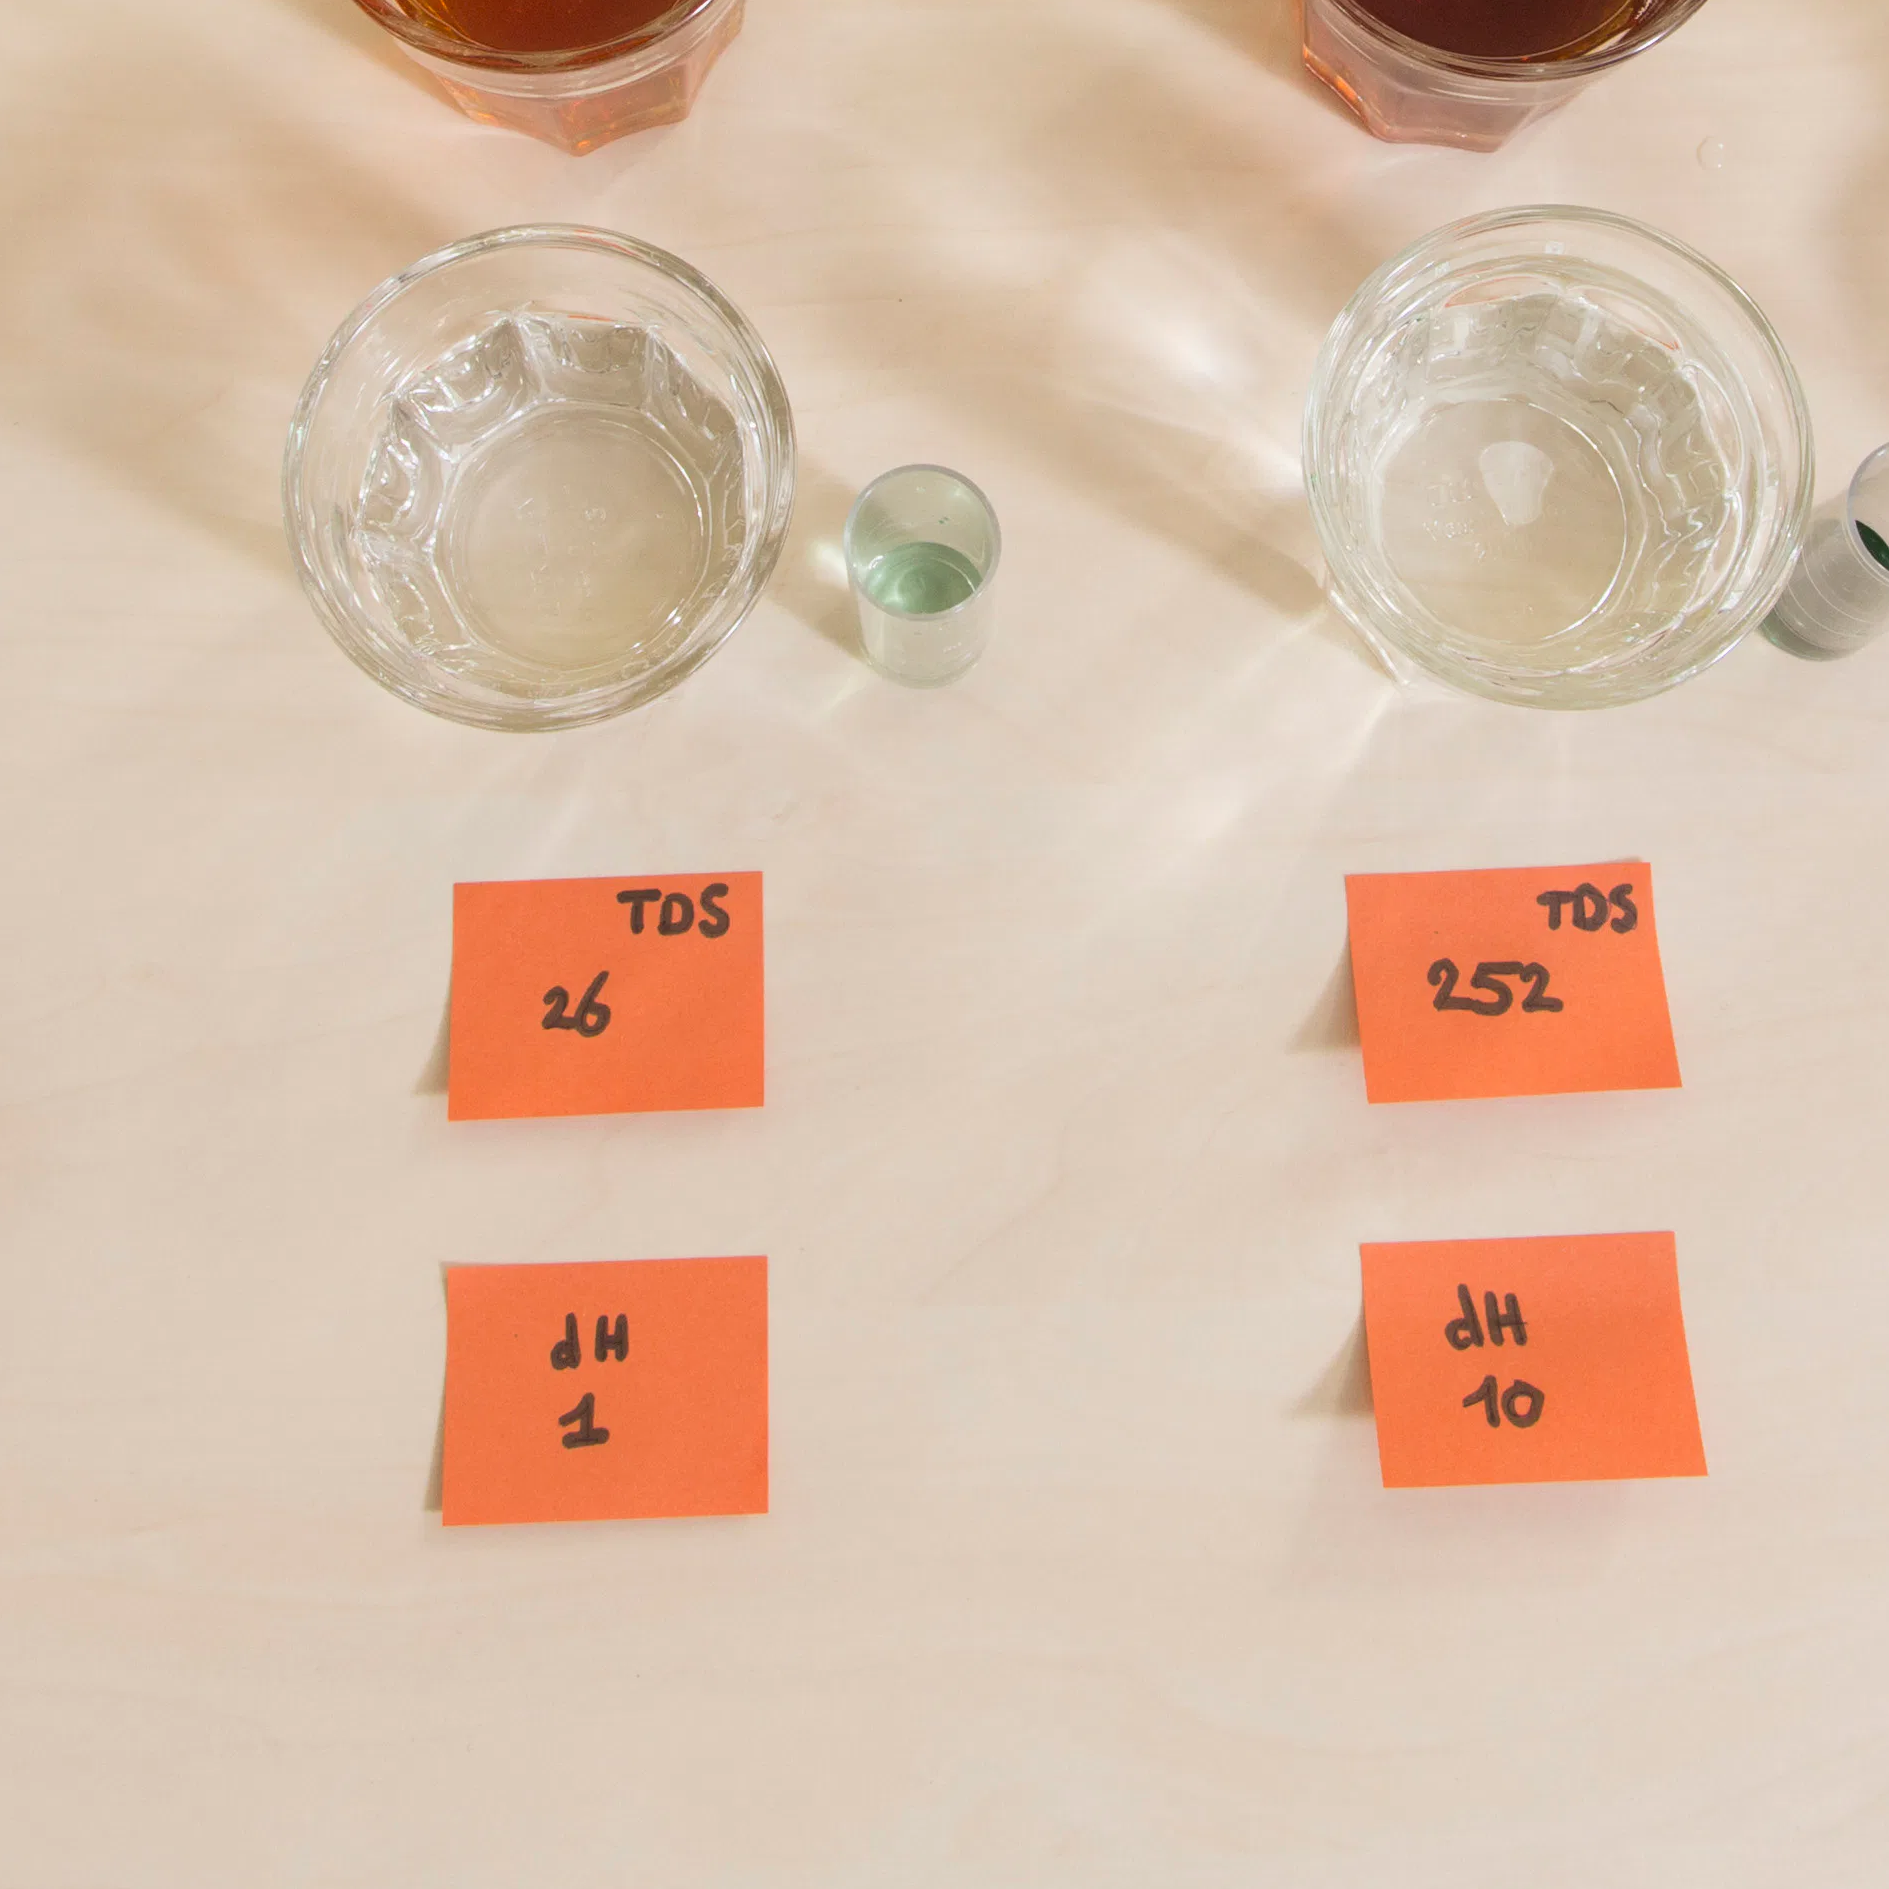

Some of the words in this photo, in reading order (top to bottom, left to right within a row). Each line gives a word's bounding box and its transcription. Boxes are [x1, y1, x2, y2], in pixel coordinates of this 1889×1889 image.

[616, 882, 730, 939] TDS
[1536, 882, 1638, 935] TDS
[541, 970, 612, 1038] 26
[1426, 957, 1564, 1017] 252
[550, 1312, 629, 1371] dH
[1444, 1283, 1528, 1351] dH
[558, 1392, 610, 1450] 1
[1462, 1374, 1546, 1429] 10
